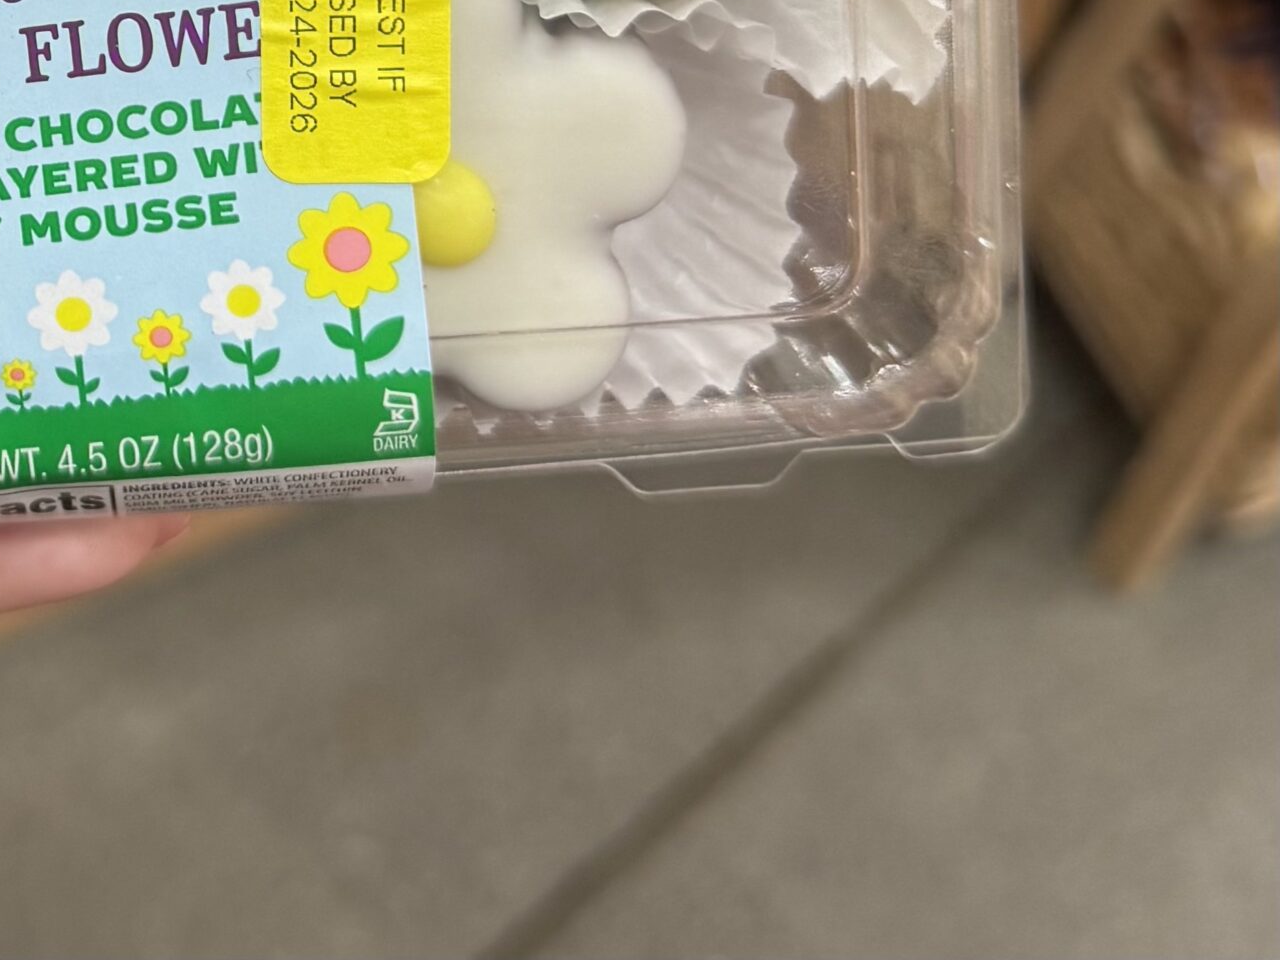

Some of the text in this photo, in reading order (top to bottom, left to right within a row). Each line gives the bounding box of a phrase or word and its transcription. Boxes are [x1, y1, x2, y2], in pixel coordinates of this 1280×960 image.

[18, 0, 262, 84] FLOWE
[329, 70, 357, 108] BY
[377, 67, 406, 93] IF
[4, 92, 262, 152] CHOCOLA
[193, 141, 262, 179] WI
[20, 192, 240, 247] MOUSSE
[58, 441, 107, 476] 4.5
[118, 435, 161, 470] OZ
[173, 425, 273, 469] (128g)
[373, 433, 419, 452] DAIRY
